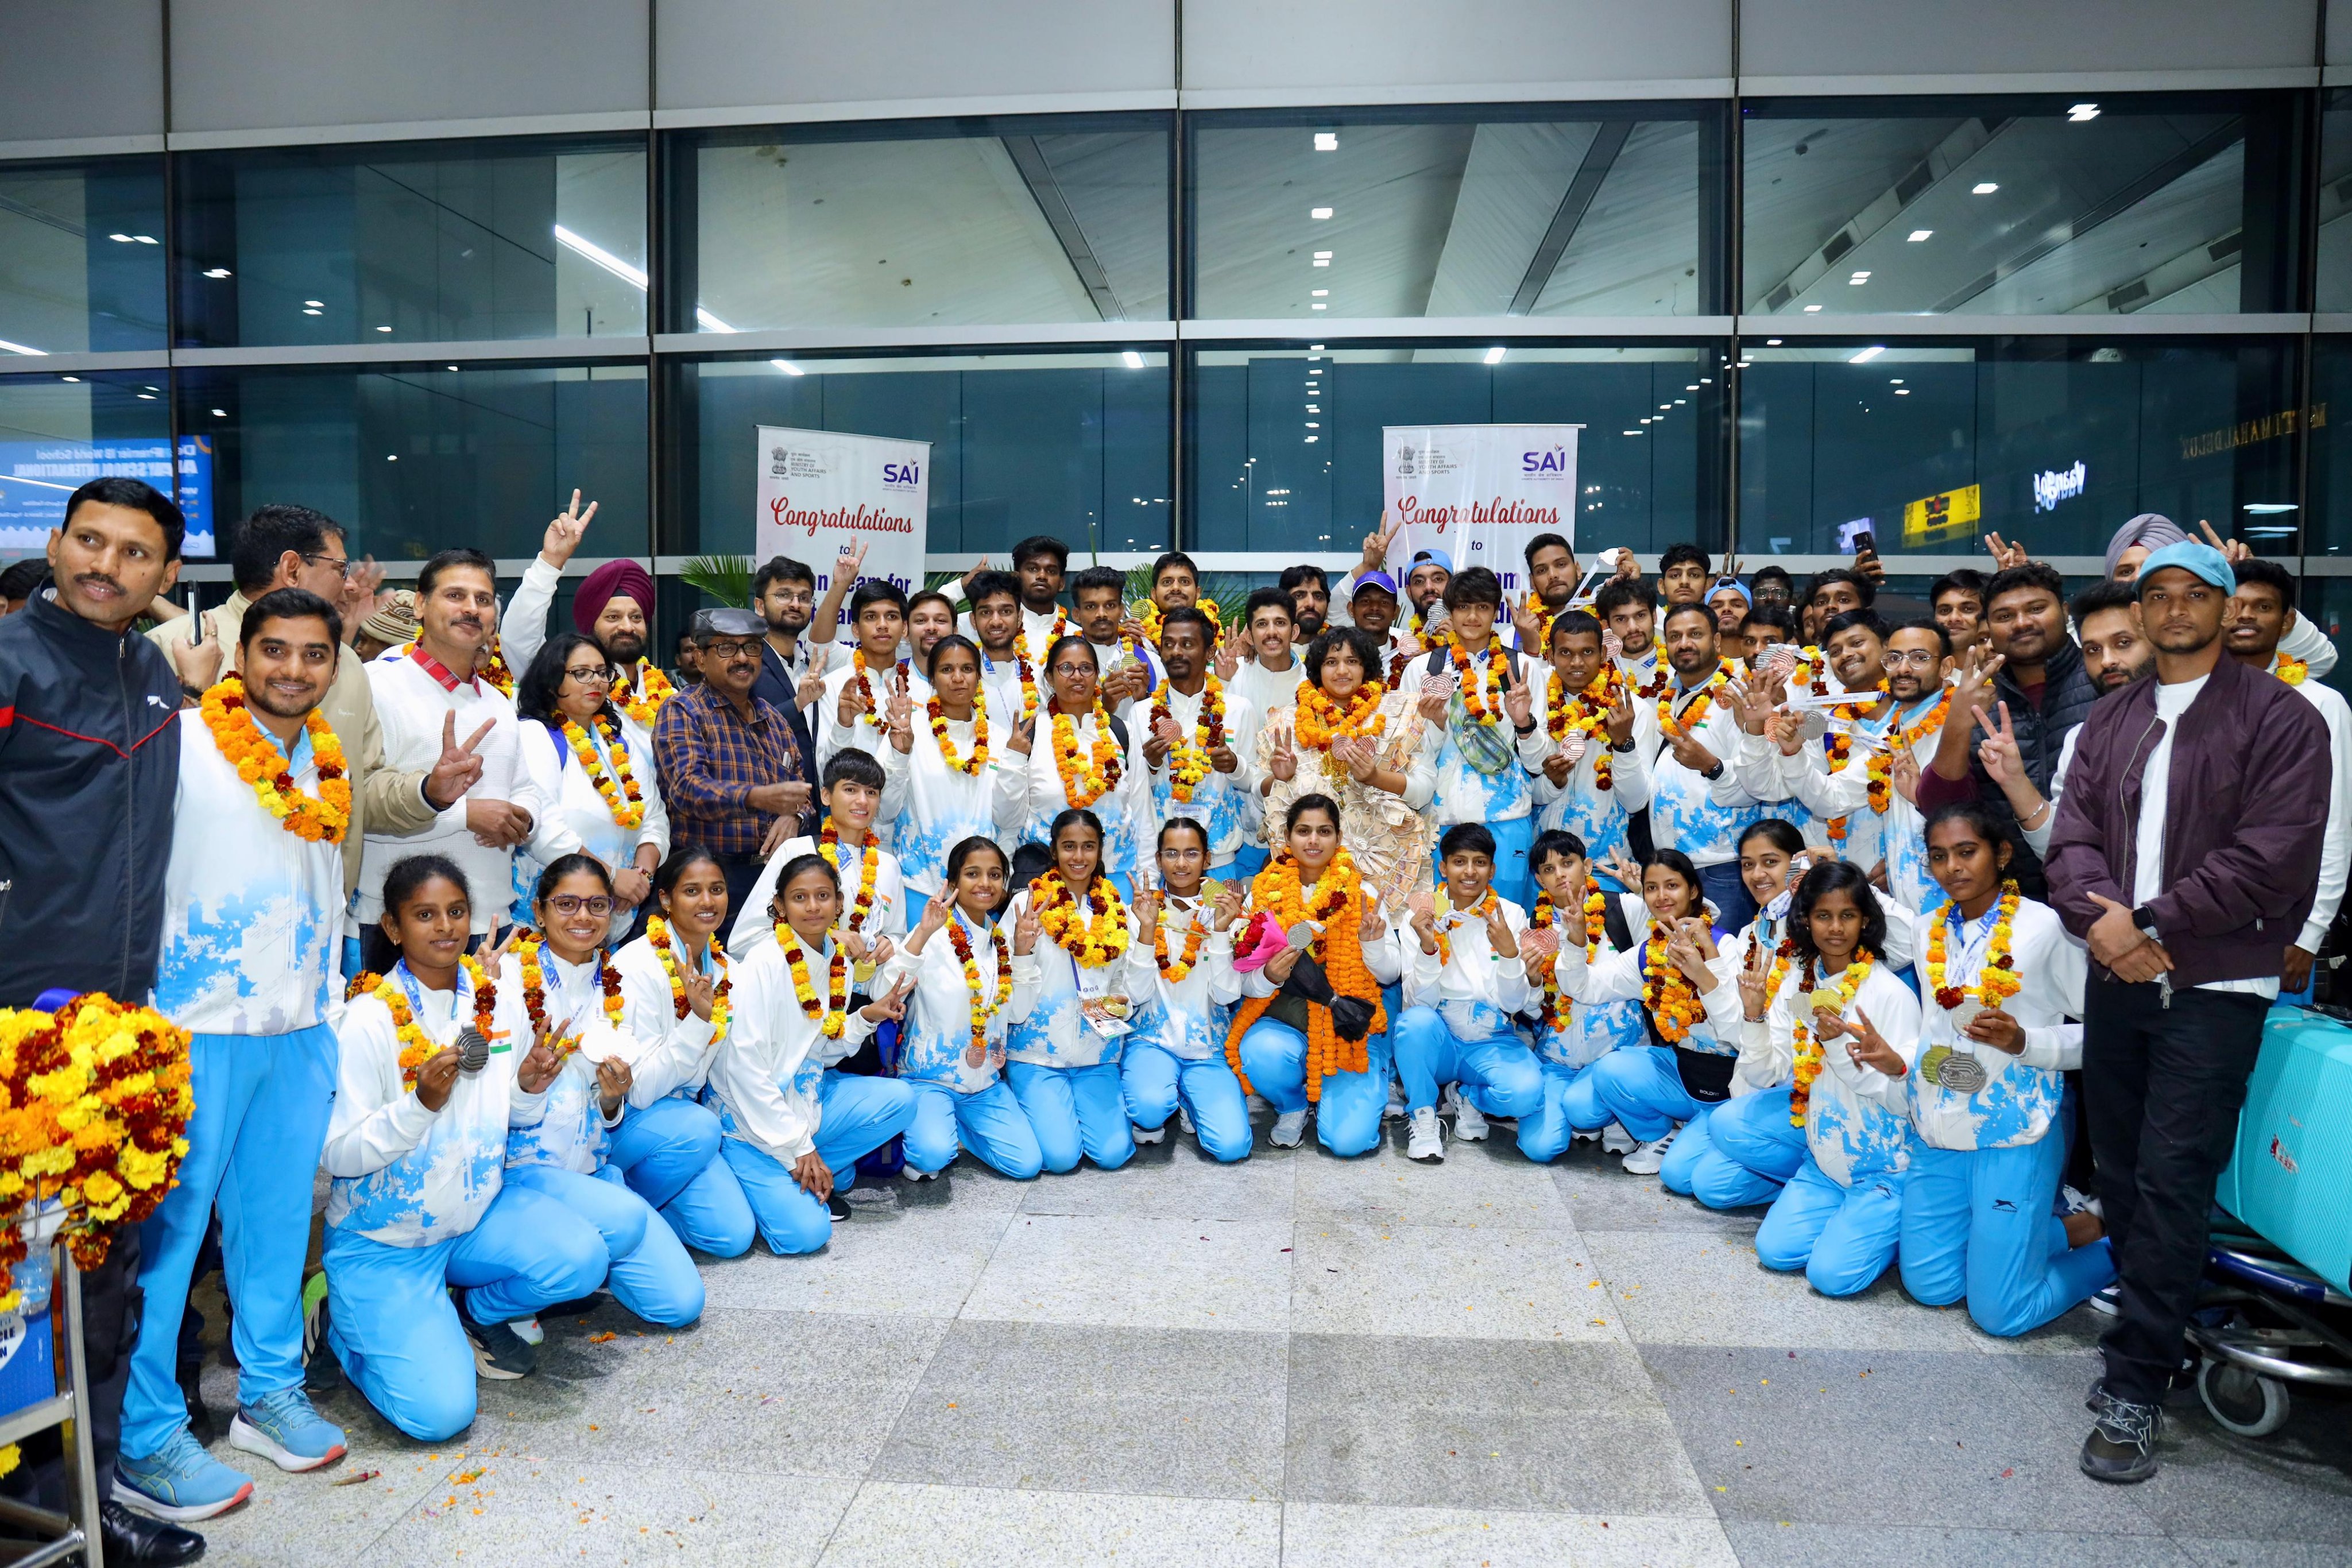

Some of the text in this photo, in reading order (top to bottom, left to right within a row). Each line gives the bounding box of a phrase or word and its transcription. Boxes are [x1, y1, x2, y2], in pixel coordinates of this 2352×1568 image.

[1522, 451, 1565, 472] SAI
[883, 463, 919, 485] SAI
[770, 496, 914, 537] Congratulations
[1397, 495, 1561, 534] Congratulations
[840, 545, 850, 555] to
[1471, 540, 1483, 551] to
[888, 572, 912, 594] for
